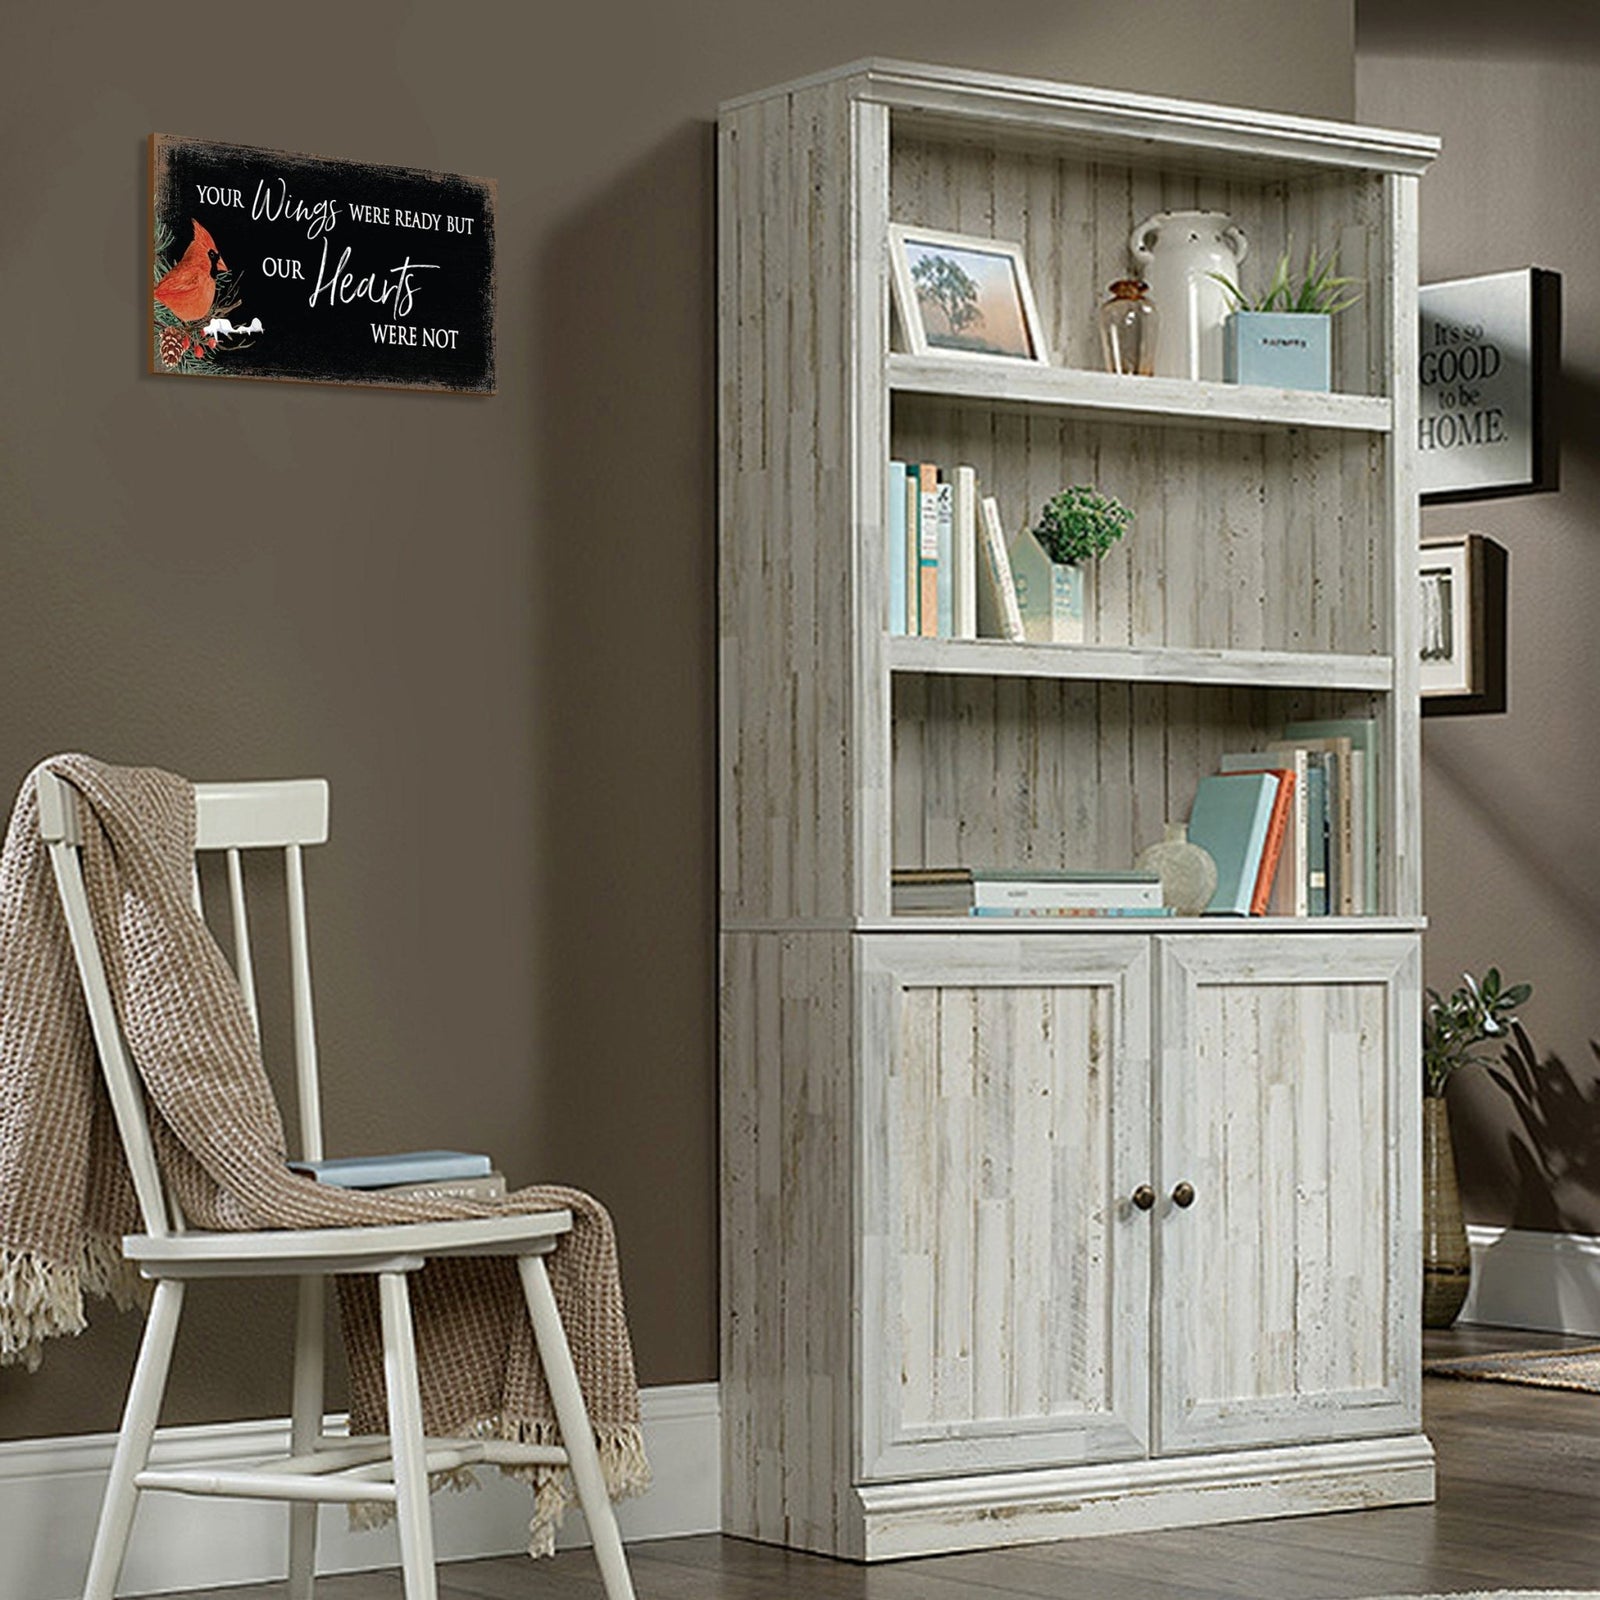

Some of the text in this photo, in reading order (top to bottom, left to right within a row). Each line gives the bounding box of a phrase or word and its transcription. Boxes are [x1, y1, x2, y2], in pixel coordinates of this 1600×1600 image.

[196, 178, 475, 239] YOUR Wings WERE READY BUT
[262, 236, 440, 321] OUR Hearts
[370, 323, 459, 349] WERE NOT
[1434, 322, 1460, 346] It's
[1419, 344, 1500, 386] GOOD
[1438, 385, 1480, 410] to be
